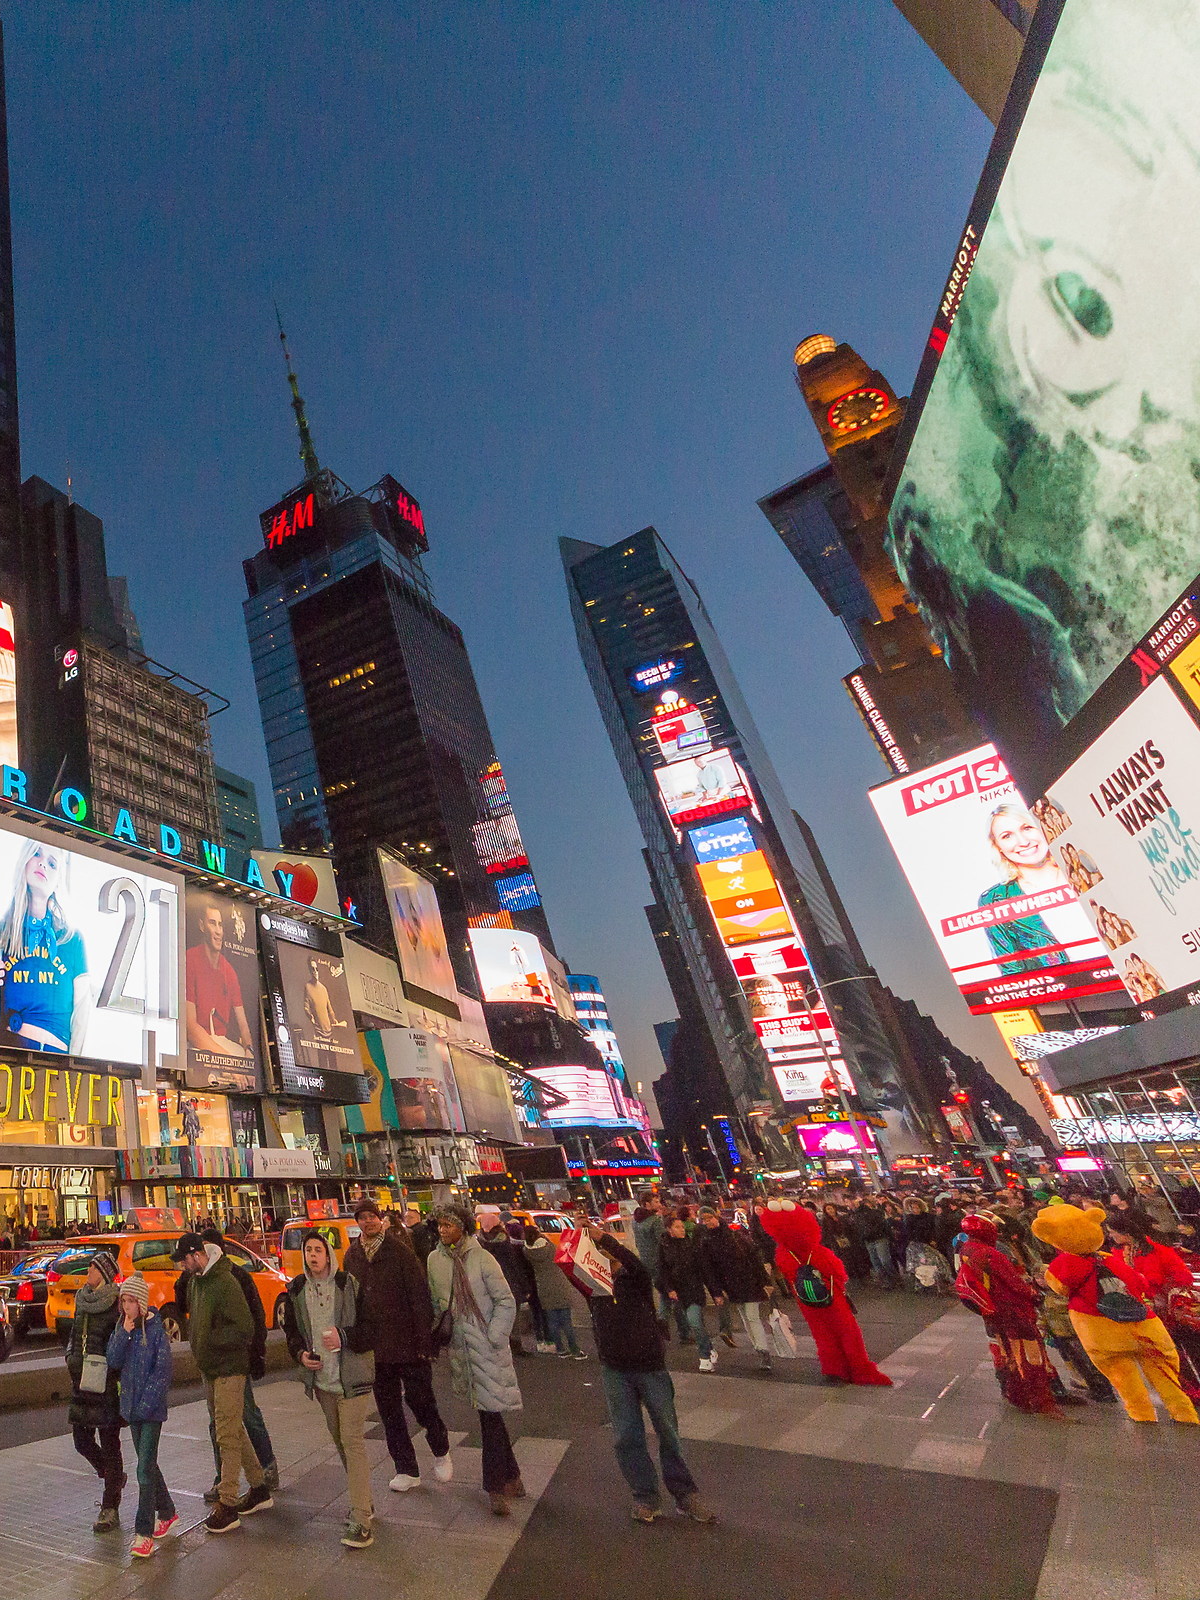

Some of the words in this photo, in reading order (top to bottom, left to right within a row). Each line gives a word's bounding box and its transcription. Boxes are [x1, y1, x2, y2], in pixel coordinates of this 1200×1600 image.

[941, 223, 977, 318] MARRIOTT
[266, 493, 314, 549] H&M
[397, 492, 425, 536] H&M
[1148, 597, 1193, 649] MARRIOTT
[1156, 616, 1198, 662] MARQUIS
[64, 666, 78, 682] LG
[651, 703, 698, 724] TOSHIBA
[654, 697, 689, 716] 2016
[850, 674, 877, 712] CHANGE
[868, 709, 897, 749] CLIMATE
[888, 746, 909, 774] CHAN
[910, 769, 967, 810] NOT
[1089, 791, 1105, 818] I
[1098, 739, 1165, 813] ALWAYS
[673, 796, 751, 825] TOSHIBA
[1115, 778, 1173, 837] WANT
[710, 831, 750, 850] TDK
[735, 898, 755, 909] ON
[947, 909, 994, 932] LIKES
[994, 905, 1011, 919] IT
[1010, 889, 1064, 915] WHEN
[271, 919, 298, 936] sunglass
[297, 926, 309, 939] hut
[96, 876, 179, 1020] 21
[3, 946, 68, 976] GRENWCH
[13, 970, 35, 984] NY.
[38, 971, 59, 985] NY.
[783, 980, 801, 991] THE
[993, 994, 1010, 1004] ON
[1009, 990, 1030, 1002] THE
[1029, 987, 1046, 998] CC
[1045, 982, 1067, 995] APP
[759, 1020, 781, 1031] THIS
[782, 1016, 811, 1028] BUD'S
[195, 1052, 211, 1064] LIVE
[211, 1055, 256, 1070] AUTHENTICALLY
[808, 1103, 840, 1113] SOY
[278, 1156, 294, 1167] POLO
[318, 1156, 332, 1171] hut
[10, 1166, 76, 1189] FOREVER
[79, 1167, 95, 1187] 21
